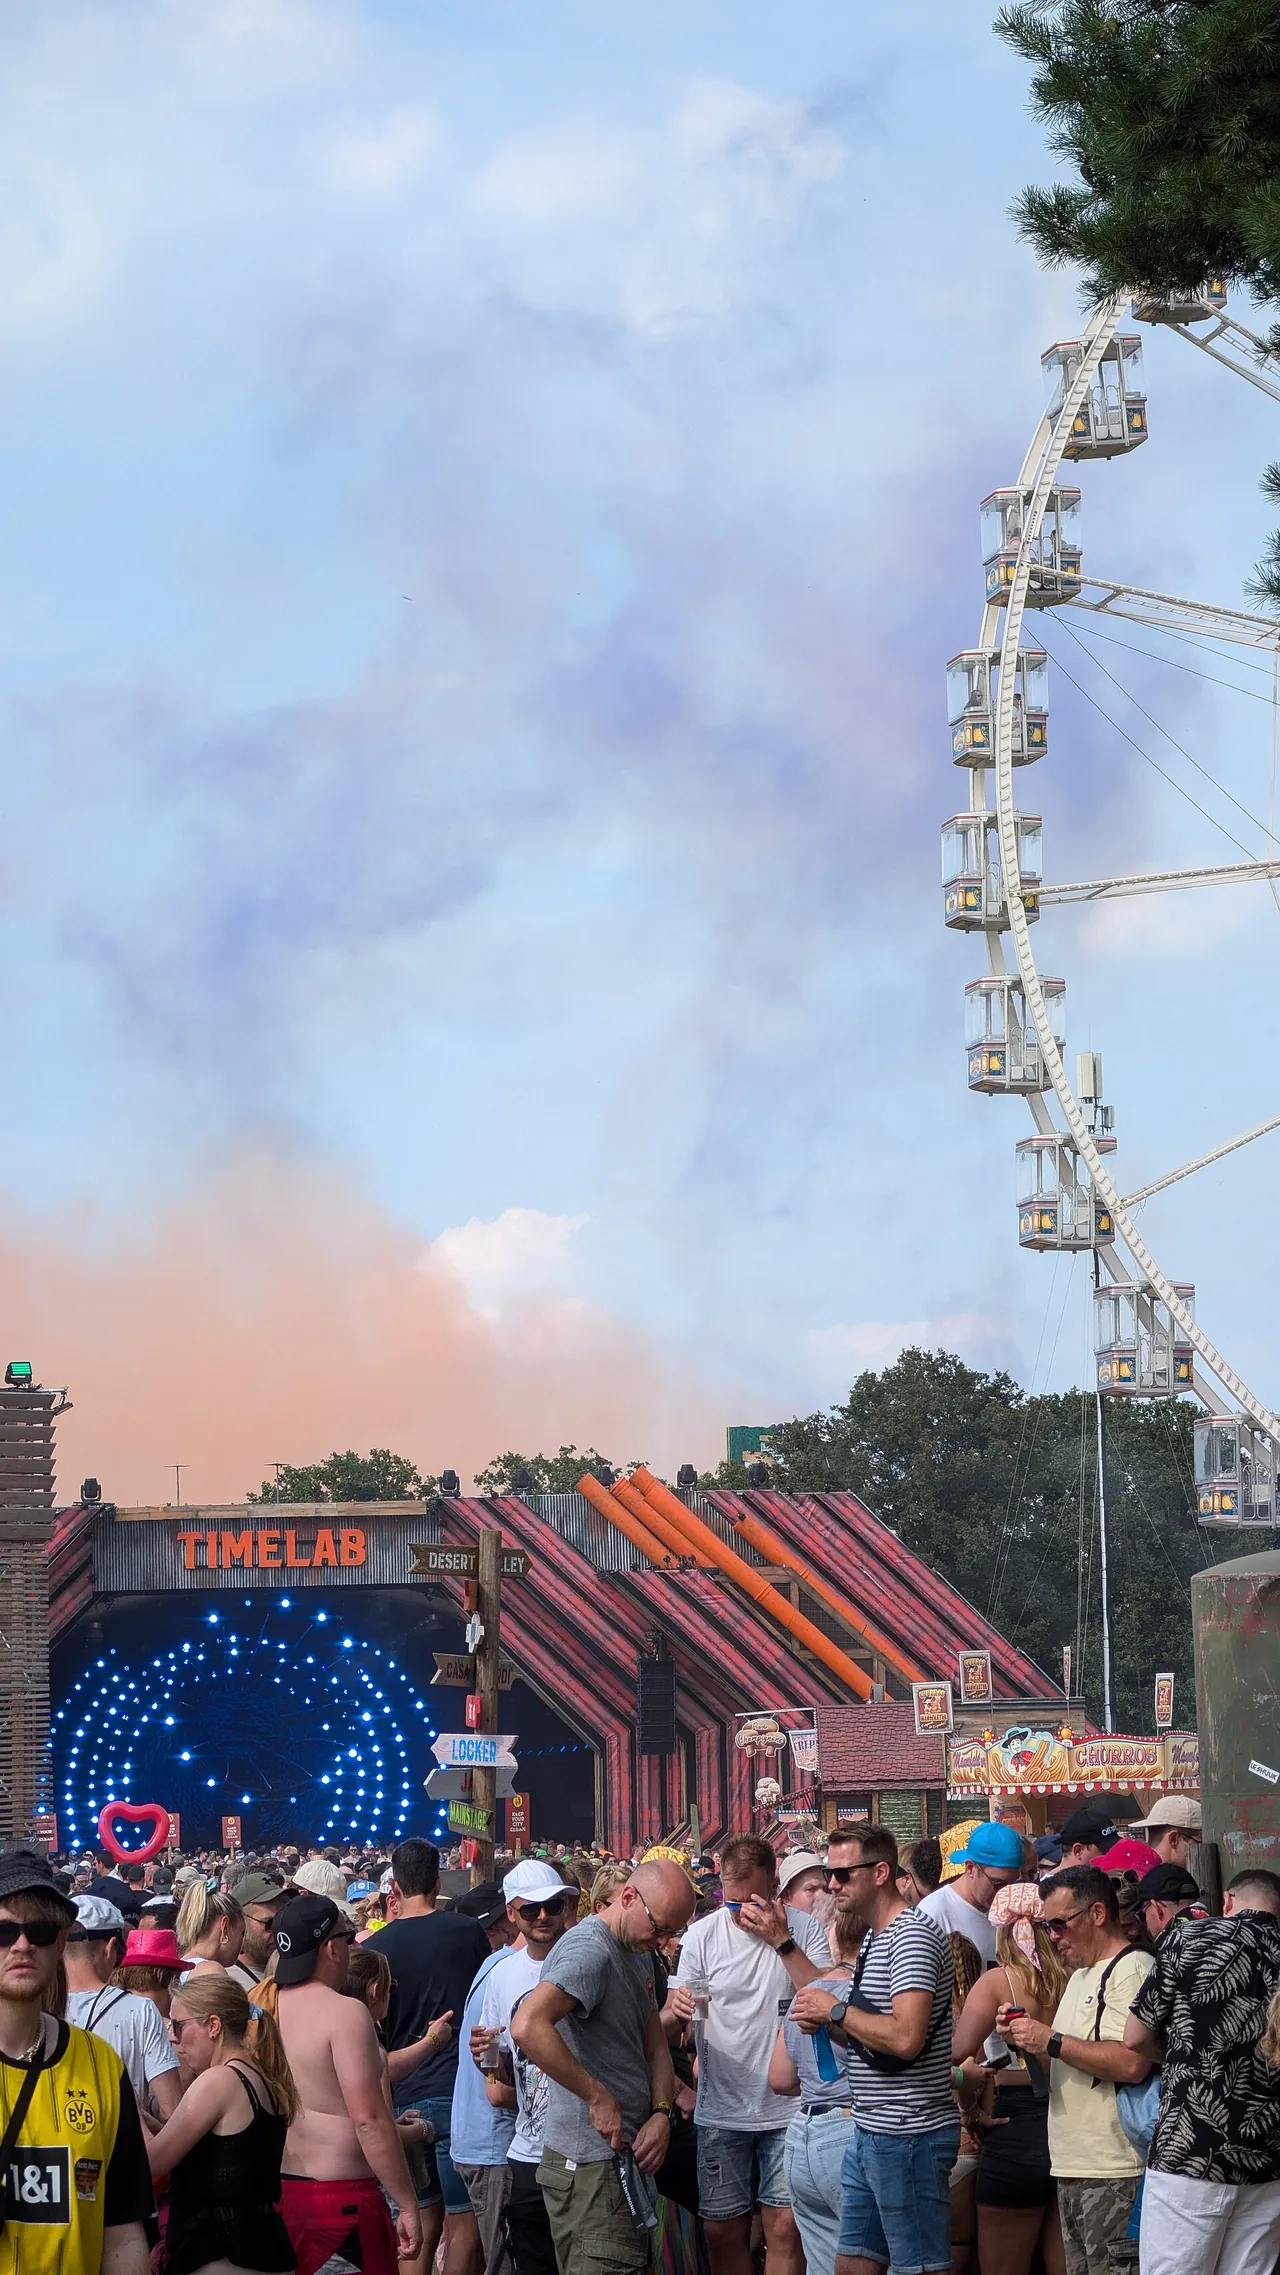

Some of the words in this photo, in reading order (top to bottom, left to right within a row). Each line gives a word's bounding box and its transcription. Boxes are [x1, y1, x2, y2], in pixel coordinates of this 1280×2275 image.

[177, 1528, 366, 1570] TIMELAB
[428, 1551, 476, 1571] DESERT
[501, 1556, 525, 1573] LEY
[452, 1739, 497, 1763] LOCKER
[1075, 1744, 1158, 1768] CHURROS
[450, 1802, 487, 1832] MAINSTAGE
[68, 2102, 94, 2124] BVB
[76, 2121, 87, 2131] 09
[9, 2163, 61, 2204] 1&1
